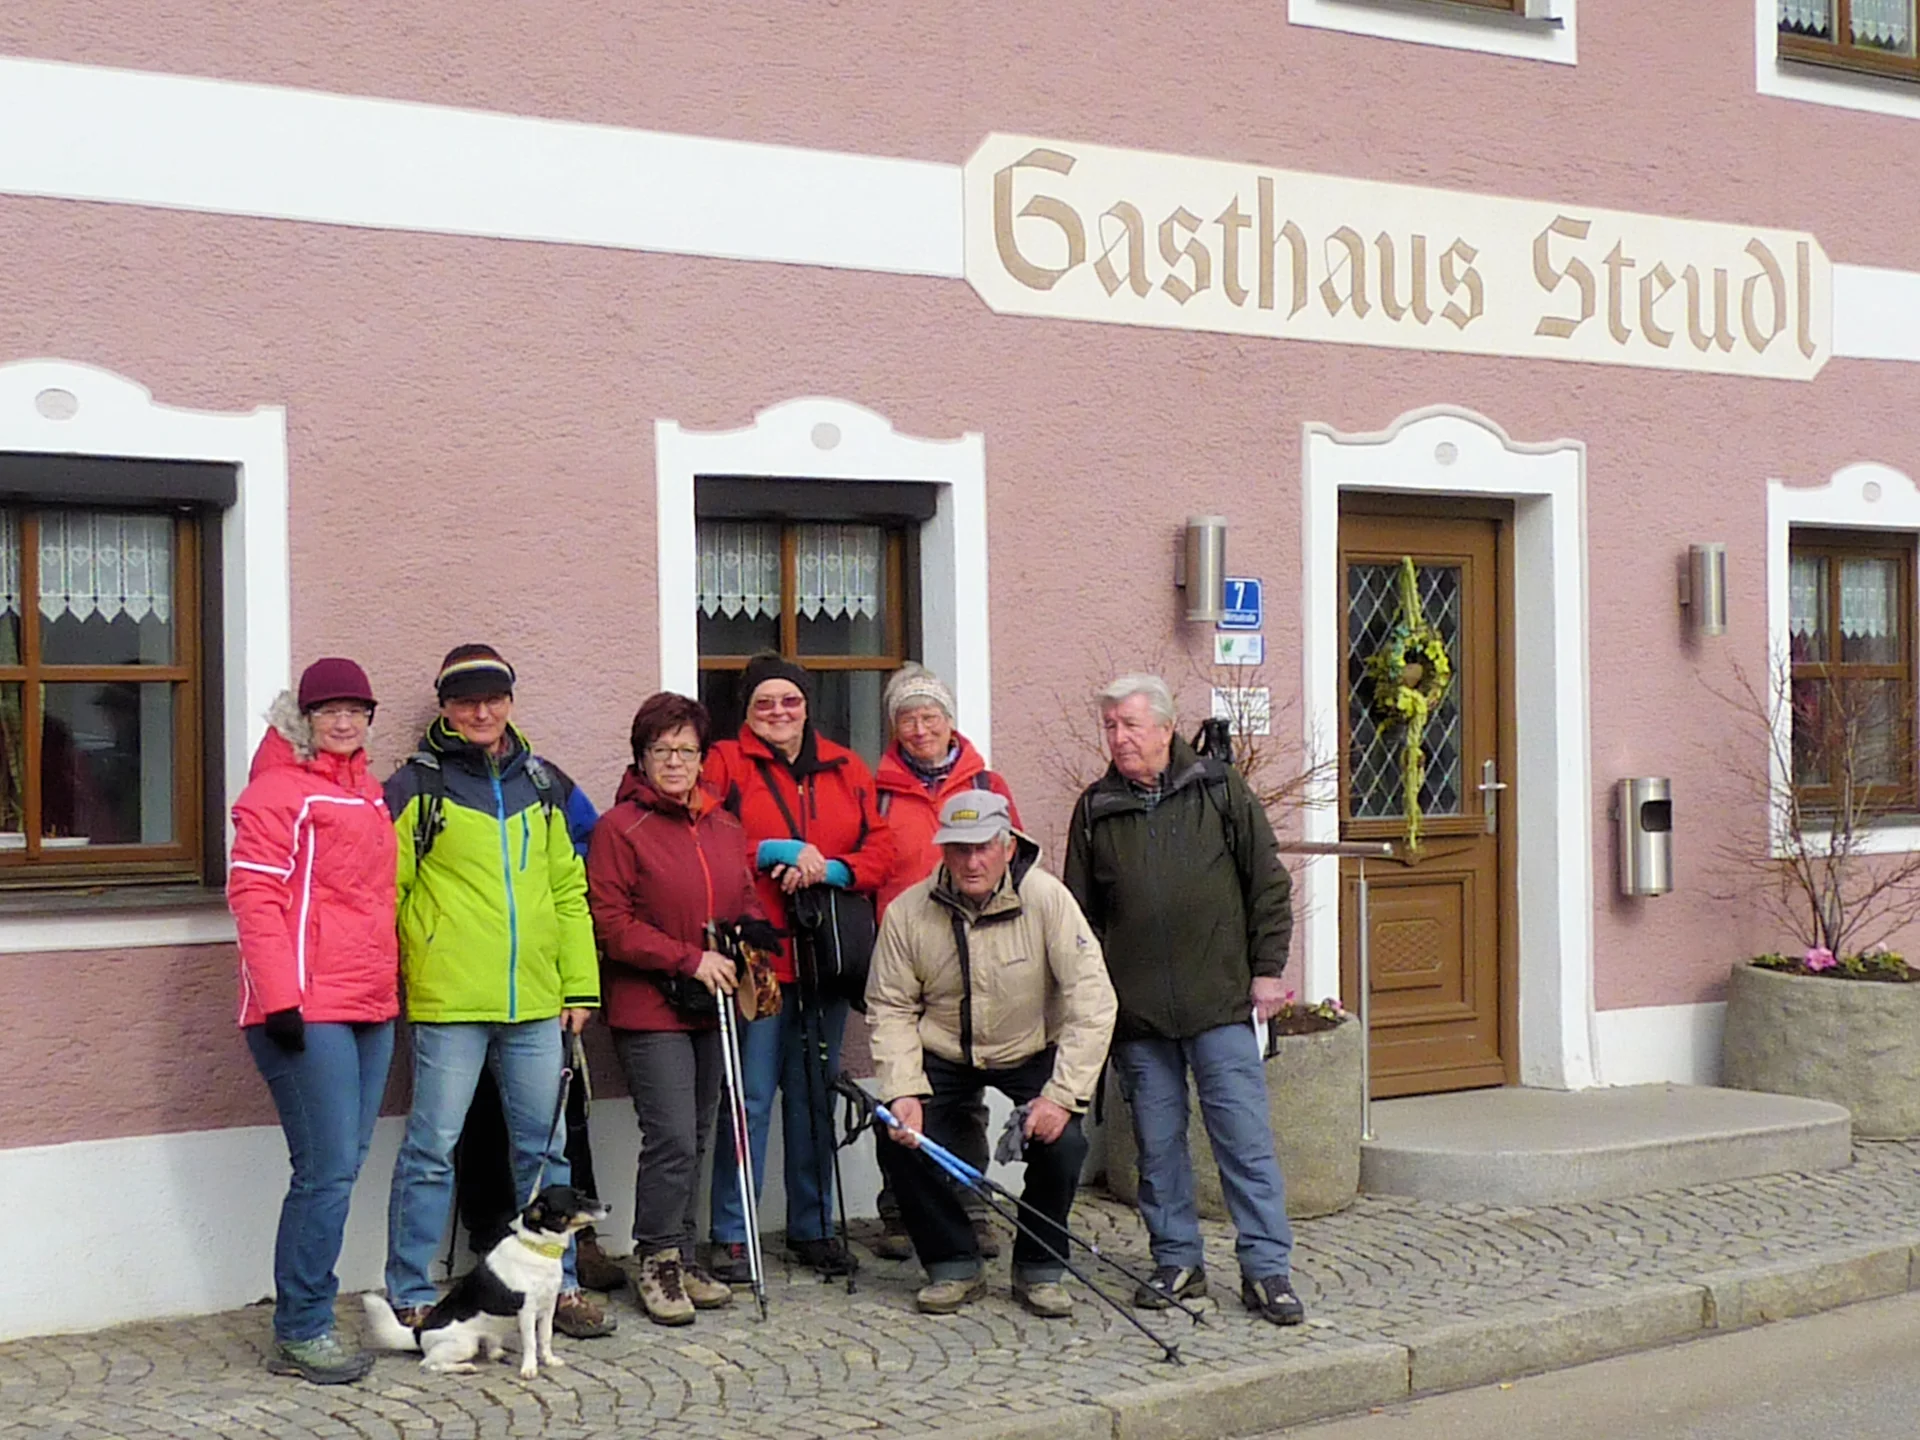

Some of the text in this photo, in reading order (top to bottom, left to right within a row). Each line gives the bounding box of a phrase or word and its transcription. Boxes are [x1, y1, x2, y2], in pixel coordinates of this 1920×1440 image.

[993, 147, 1818, 360] Gasthaus Steudl
[1234, 581, 1245, 610] 7
